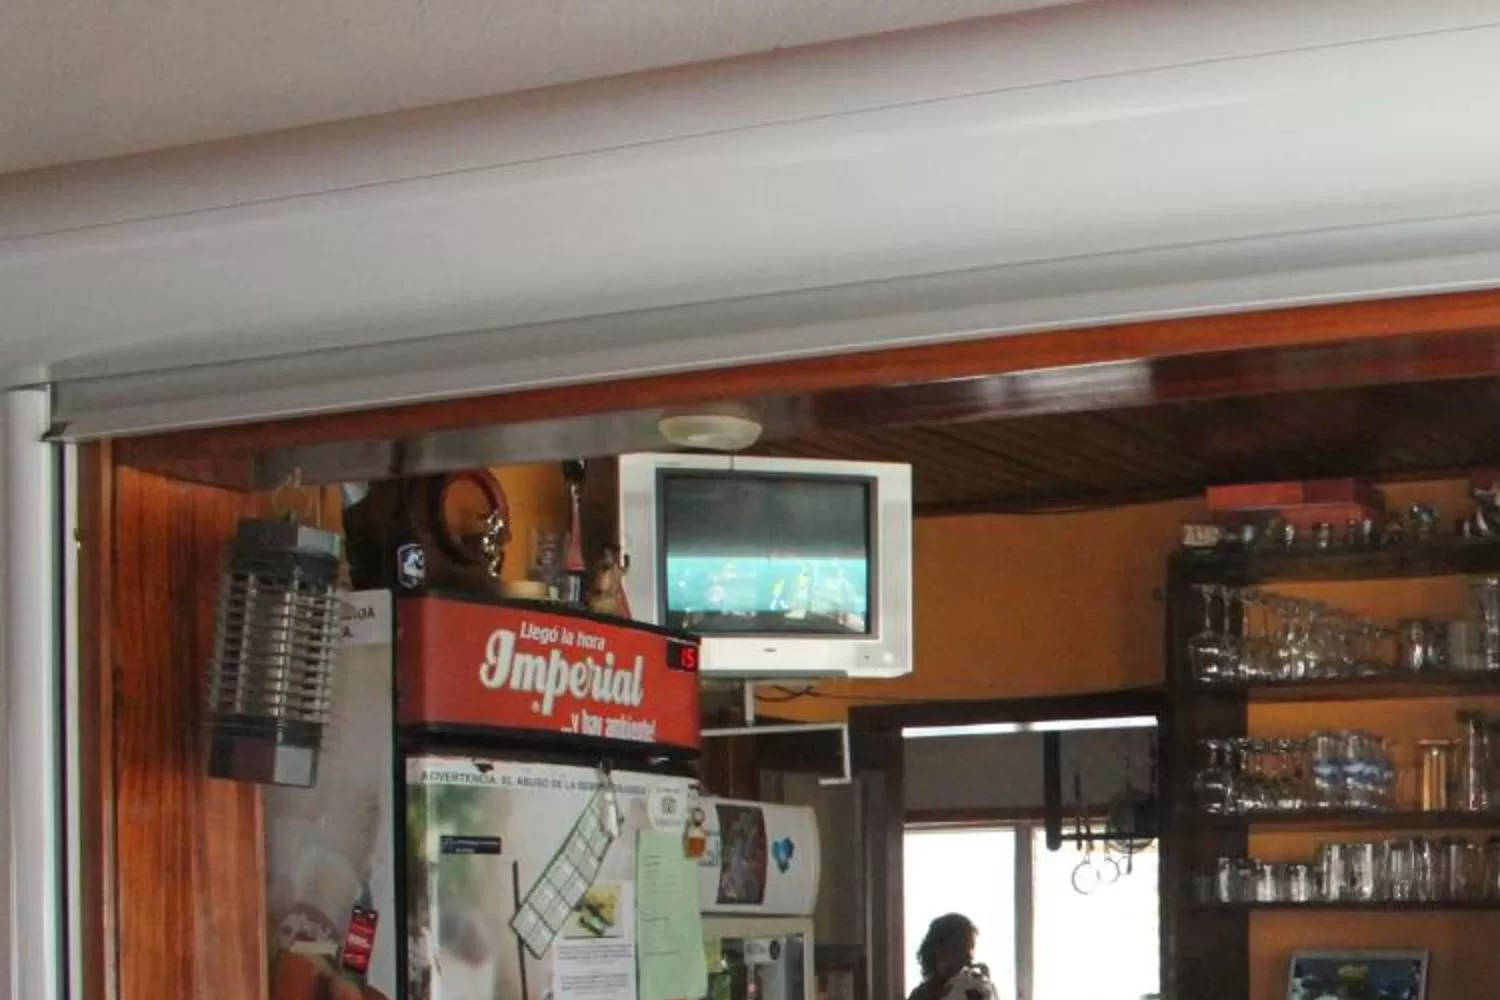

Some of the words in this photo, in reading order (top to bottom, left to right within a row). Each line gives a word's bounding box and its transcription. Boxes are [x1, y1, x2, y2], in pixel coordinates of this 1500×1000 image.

[519, 620, 558, 646] Llegó
[561, 627, 575, 646] la
[576, 631, 606, 651] hora
[479, 629, 645, 716] Imperial
